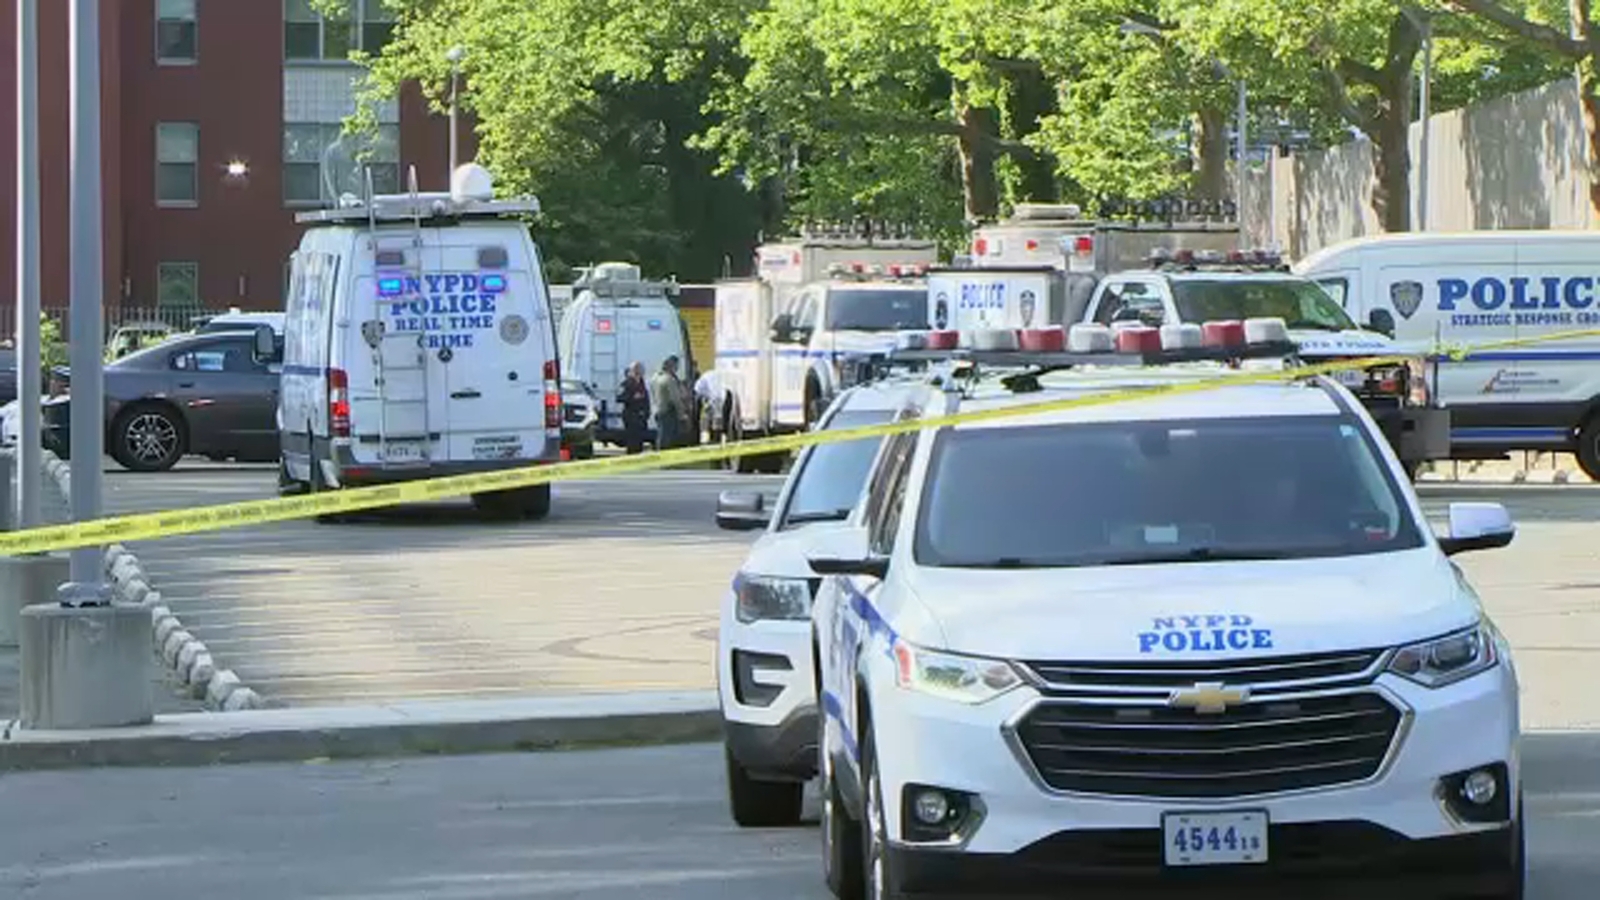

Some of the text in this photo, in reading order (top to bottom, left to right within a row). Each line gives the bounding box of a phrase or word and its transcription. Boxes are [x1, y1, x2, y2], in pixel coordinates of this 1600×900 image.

[405, 274, 478, 294] NYPD
[1437, 276, 1600, 310] POLIC
[392, 295, 495, 315] POLICE
[960, 283, 1005, 309] POLICE
[395, 315, 493, 331] REAL TIME
[1451, 312, 1600, 327] STRATEGIC RESPONSE GRO
[417, 334, 473, 348] CRIME
[1152, 614, 1254, 629] NYPD
[1138, 629, 1274, 653] POLICE
[1174, 826, 1238, 852] 4544
